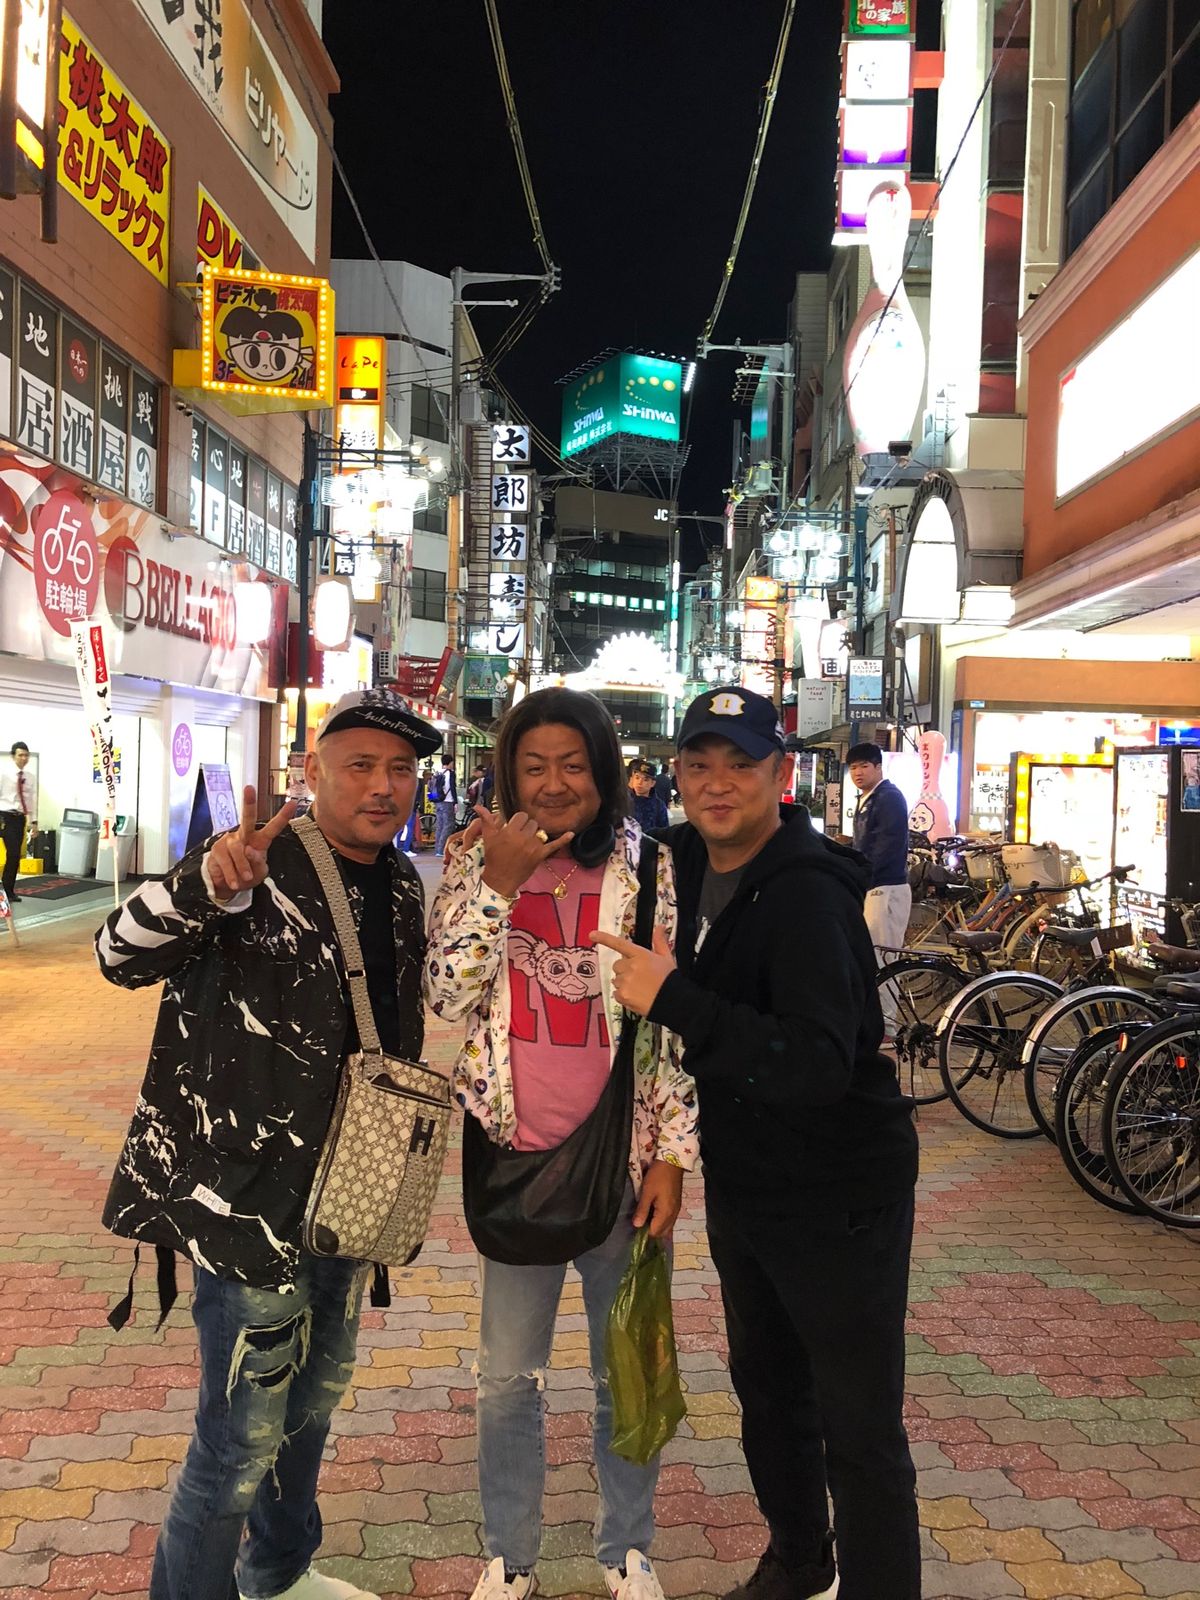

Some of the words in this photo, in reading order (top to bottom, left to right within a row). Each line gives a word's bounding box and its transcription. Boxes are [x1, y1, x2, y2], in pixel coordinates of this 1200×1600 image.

[60, 33, 167, 195] 桃太郎
[244, 66, 314, 204] ビリヤード
[58, 100, 165, 273] &リラックス
[199, 197, 243, 270] DV
[217, 283, 256, 306] ビデオ
[215, 359, 237, 381] 3F
[45, 578, 88, 617] 駐輪場
